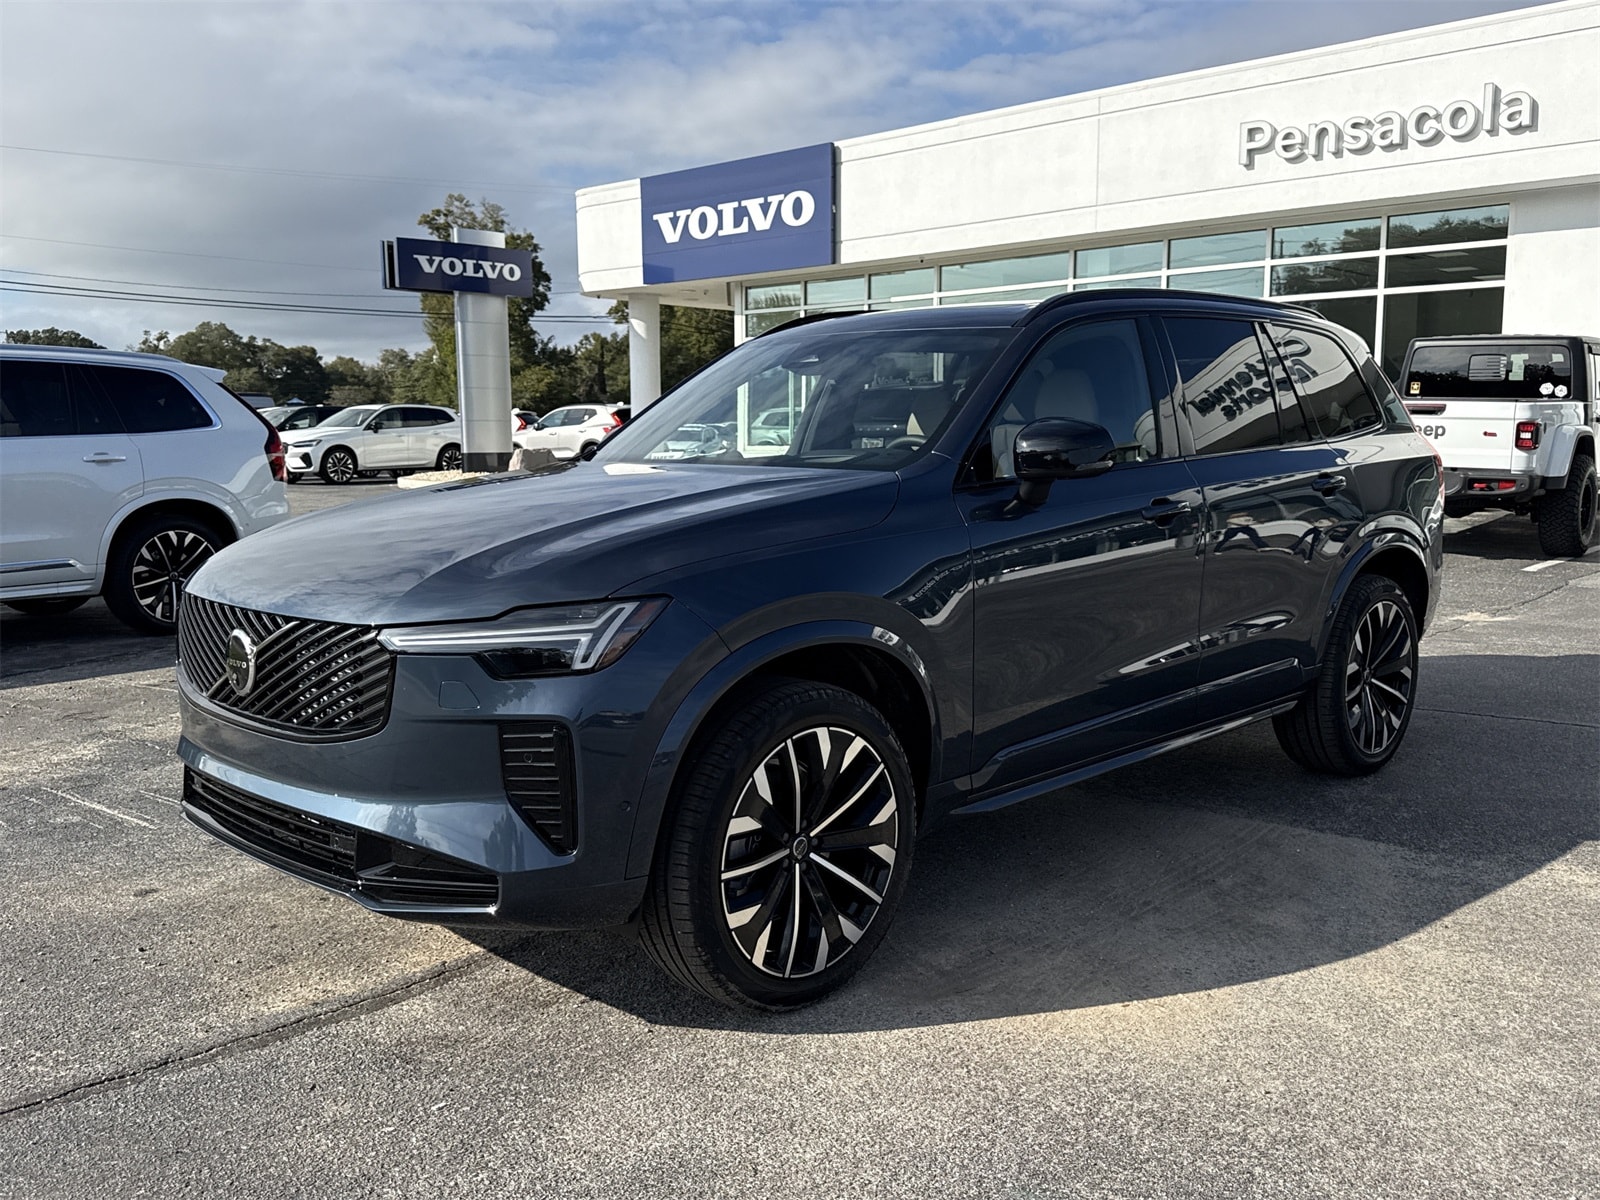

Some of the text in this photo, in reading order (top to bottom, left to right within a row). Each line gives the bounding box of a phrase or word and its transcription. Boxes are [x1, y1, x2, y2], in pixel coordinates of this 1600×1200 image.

[1238, 82, 1539, 170] Pensacola
[652, 190, 816, 244] VOLVO
[412, 254, 522, 282] VOLVO
[1415, 425, 1446, 439] eep
